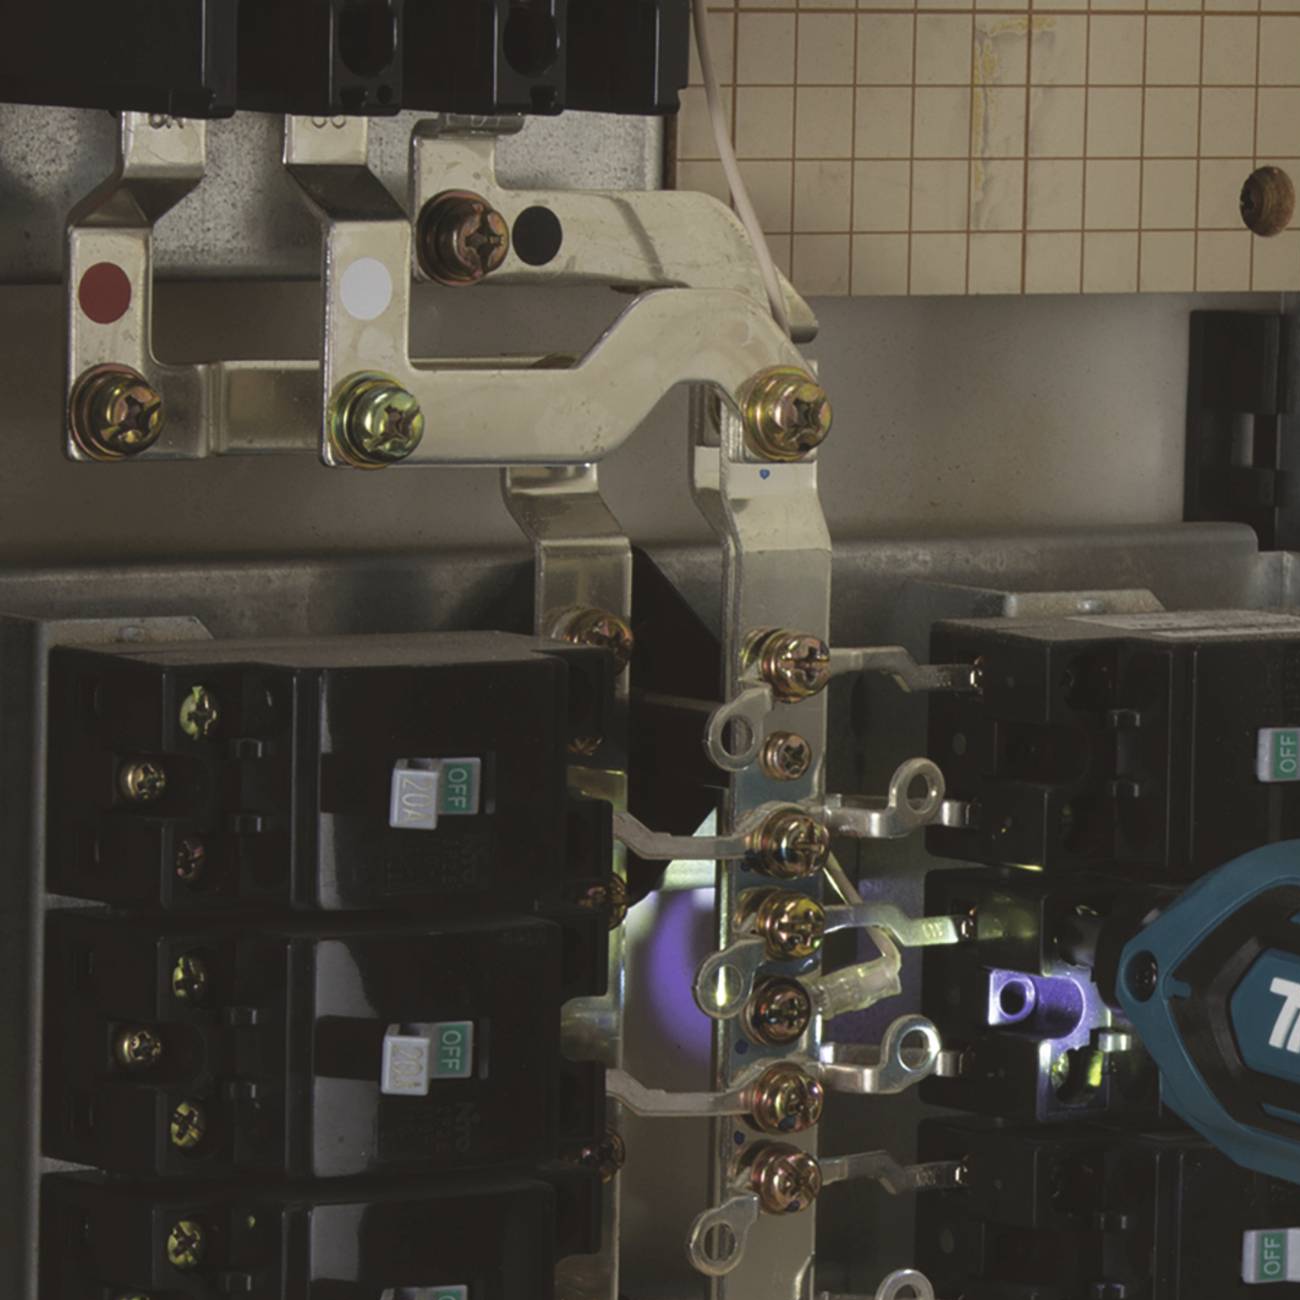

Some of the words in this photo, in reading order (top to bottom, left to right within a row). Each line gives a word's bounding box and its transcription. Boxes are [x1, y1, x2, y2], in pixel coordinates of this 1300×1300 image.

[1280, 735, 1297, 773] OFF
[401, 777, 434, 820] 20A
[448, 768, 468, 808] OFF
[442, 1030, 462, 1071] OFF
[1264, 1237, 1280, 1275] OFF
